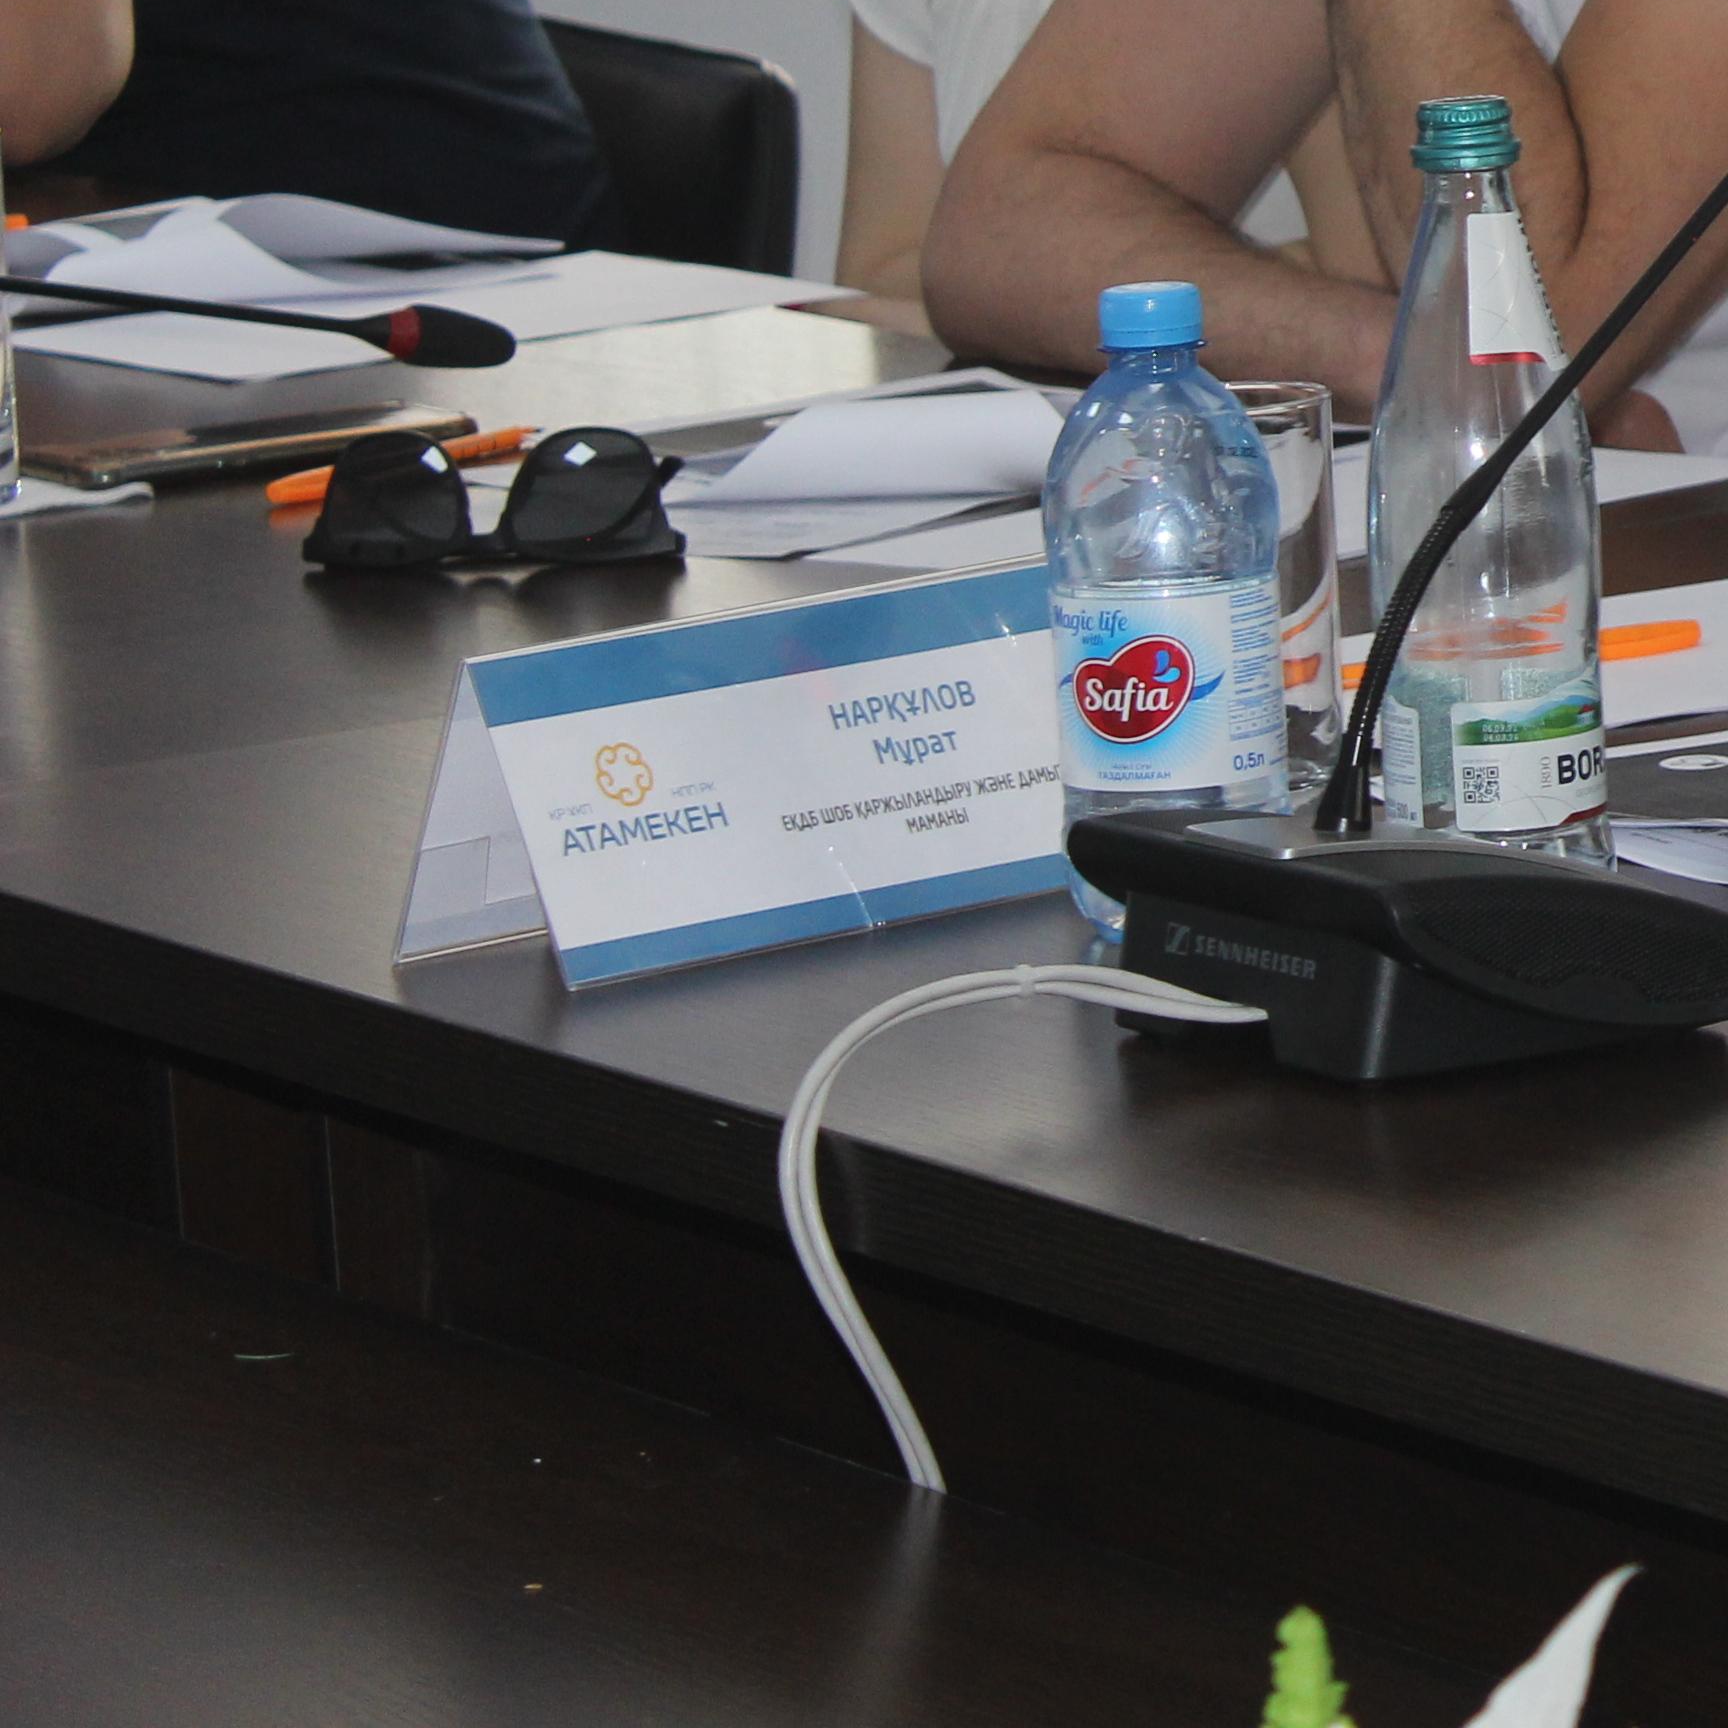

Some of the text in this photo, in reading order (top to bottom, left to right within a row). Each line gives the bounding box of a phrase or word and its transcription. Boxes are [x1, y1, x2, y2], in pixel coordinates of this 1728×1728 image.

[1099, 609, 1128, 638] life
[1083, 676, 1174, 722] Safia
[872, 730, 958, 766] Мұрат
[562, 801, 730, 857] АТАМЕКЕН
[820, 804, 855, 825] ШОБ
[905, 807, 971, 834] МАМАНЫ
[1194, 934, 1317, 980] SENNHEISER
